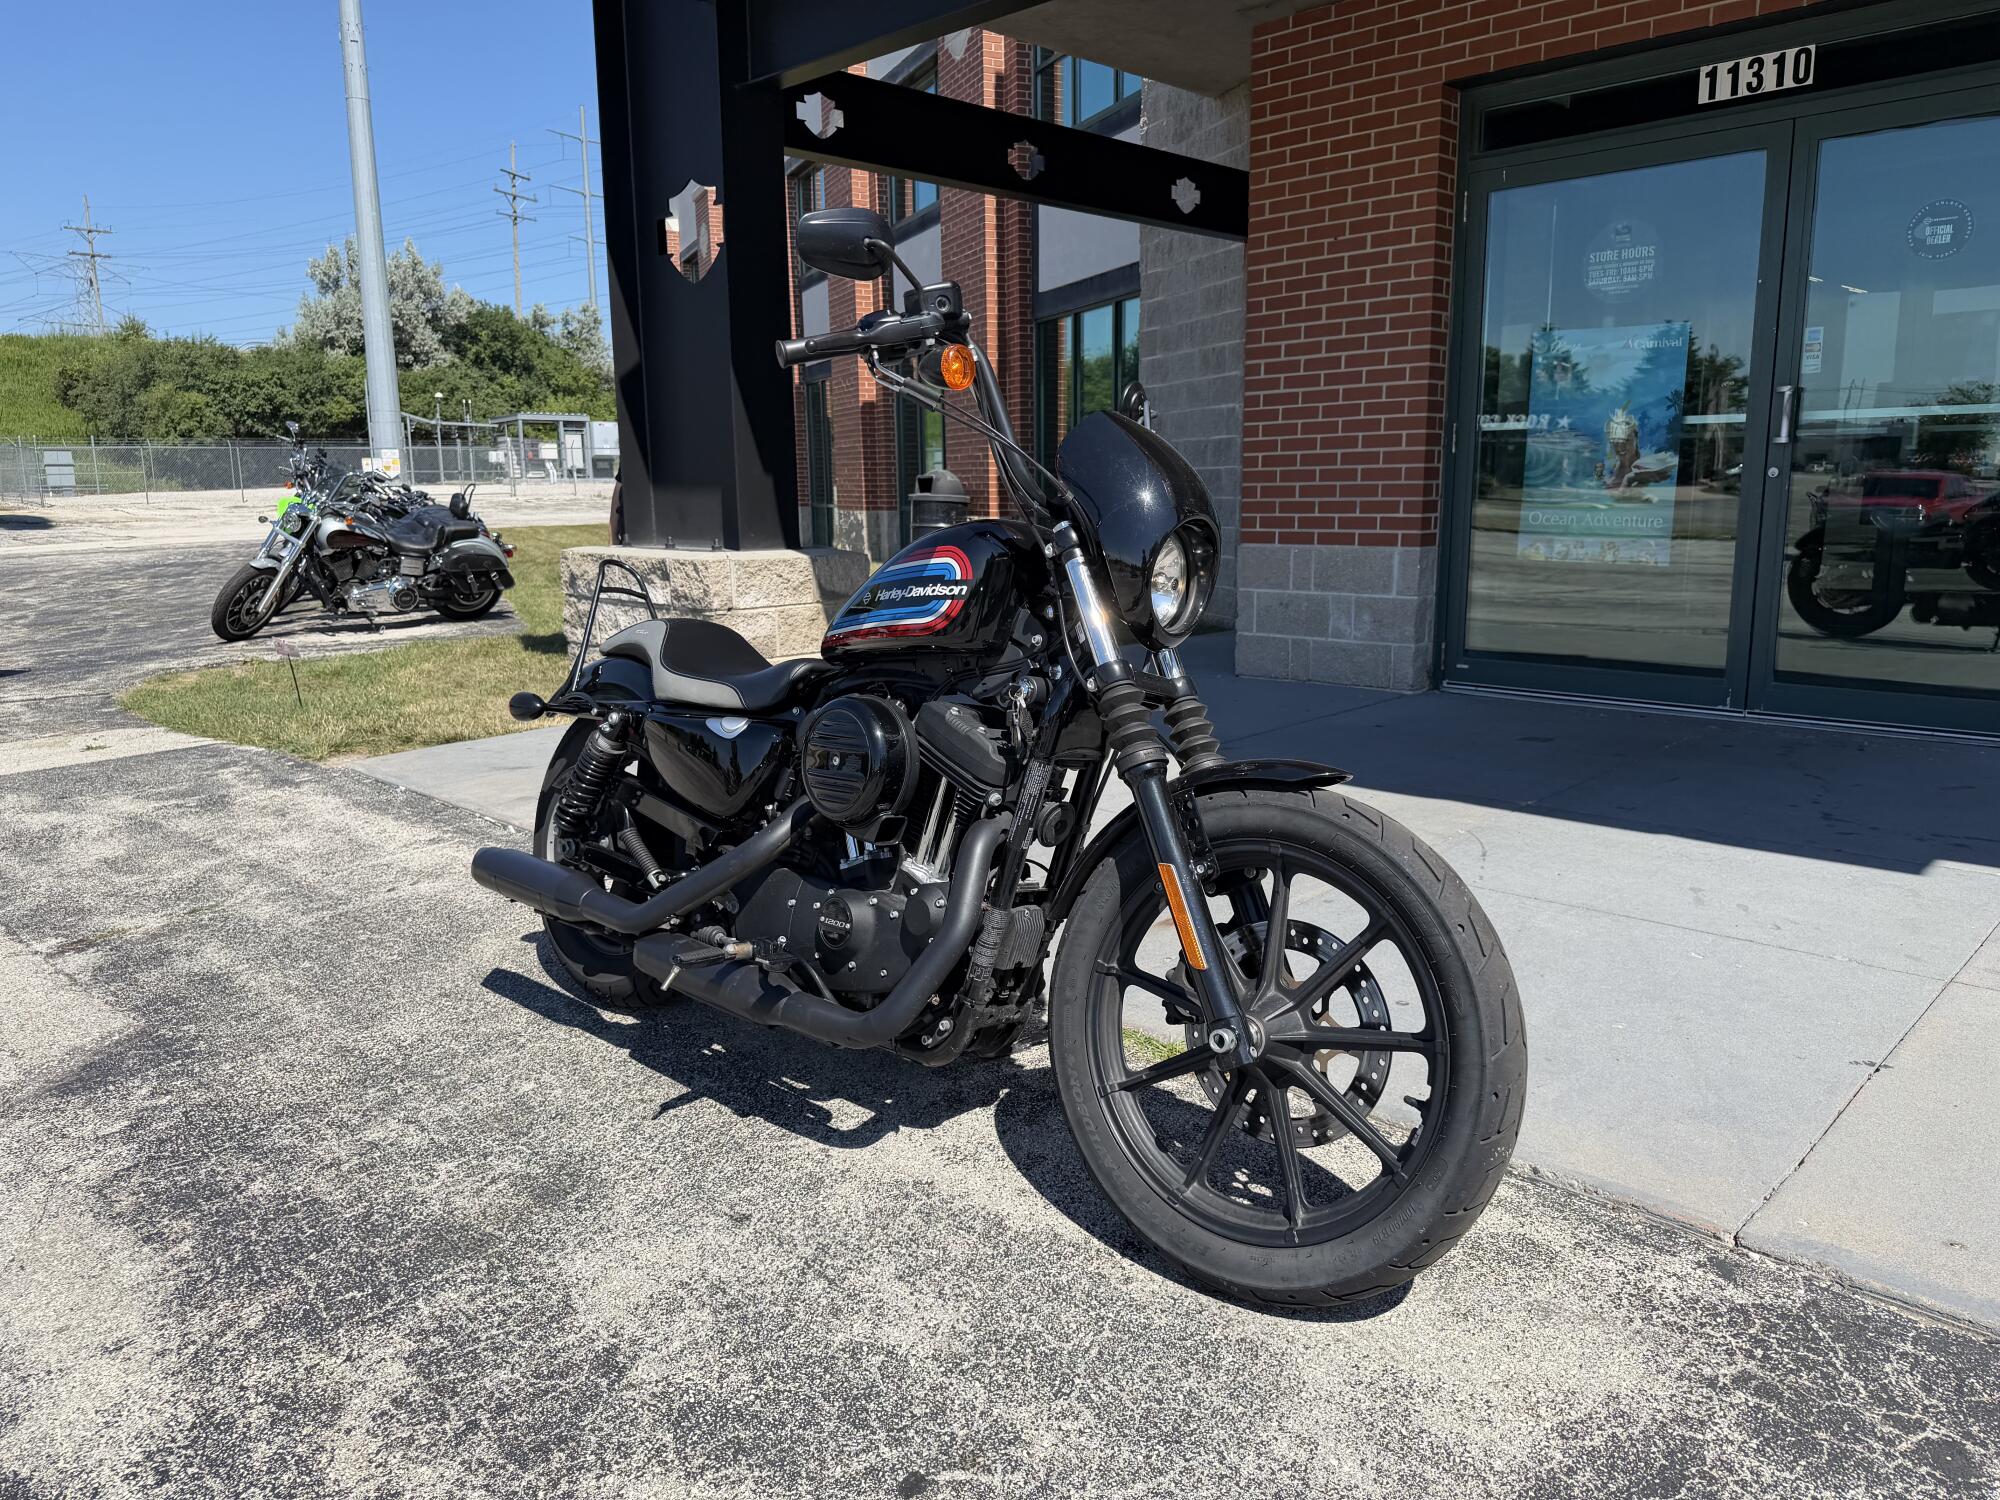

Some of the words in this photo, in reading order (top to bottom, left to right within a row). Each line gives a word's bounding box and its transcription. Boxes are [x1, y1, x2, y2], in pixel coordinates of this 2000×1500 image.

[1705, 46, 1812, 101] 11310
[1925, 224, 1954, 236] OFFICIAL
[1926, 234, 1951, 245] DEALER
[1589, 250, 1619, 263] STORE
[1621, 246, 1656, 260] HOURS
[1634, 336, 1683, 350] Carnival
[1528, 511, 1576, 526] Ocean
[1581, 512, 1664, 529] Adventure
[875, 583, 968, 602] Harley-Davidson
[825, 918, 845, 928] 1200
